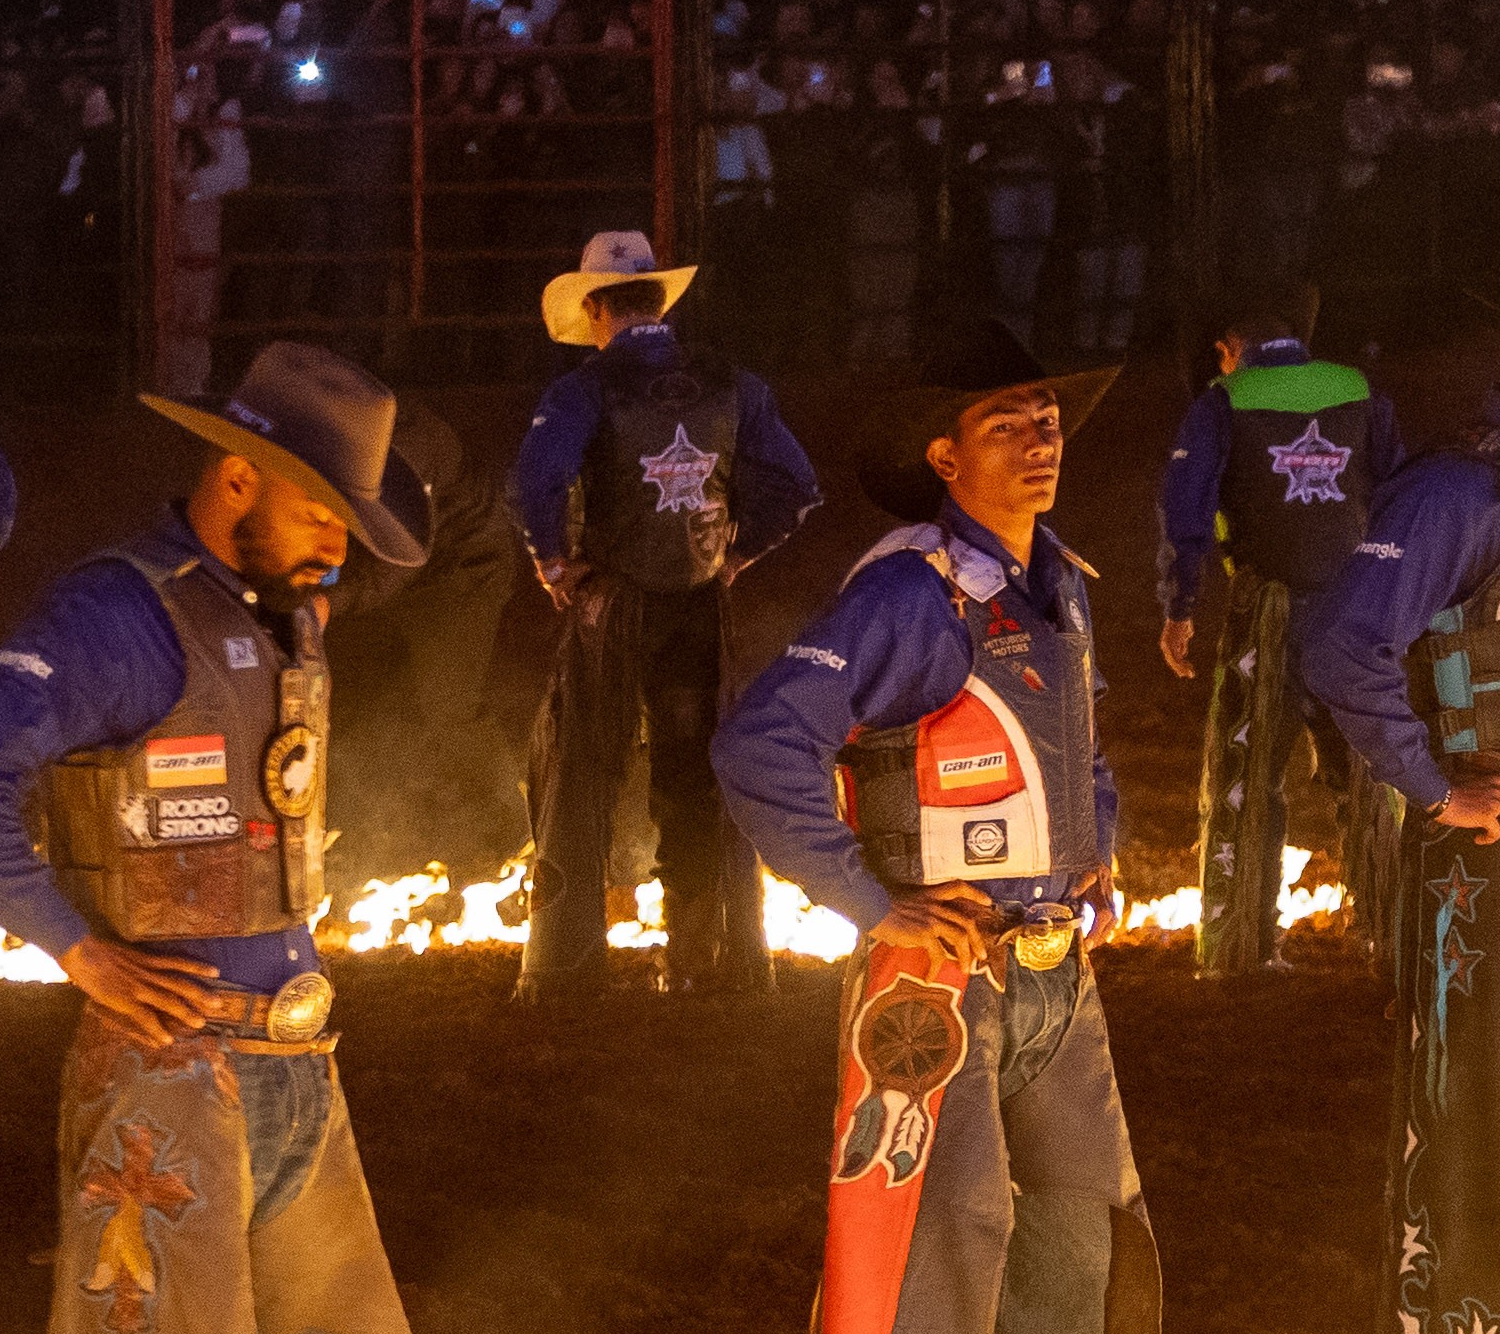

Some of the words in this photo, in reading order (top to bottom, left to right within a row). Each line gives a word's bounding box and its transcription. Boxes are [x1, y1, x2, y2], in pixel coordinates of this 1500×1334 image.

[991, 642, 1030, 658] MOTORS
[153, 753, 224, 768] can-am
[942, 753, 1004, 773] can-am
[159, 797, 230, 817] RODEO
[158, 816, 240, 838] STRONG
